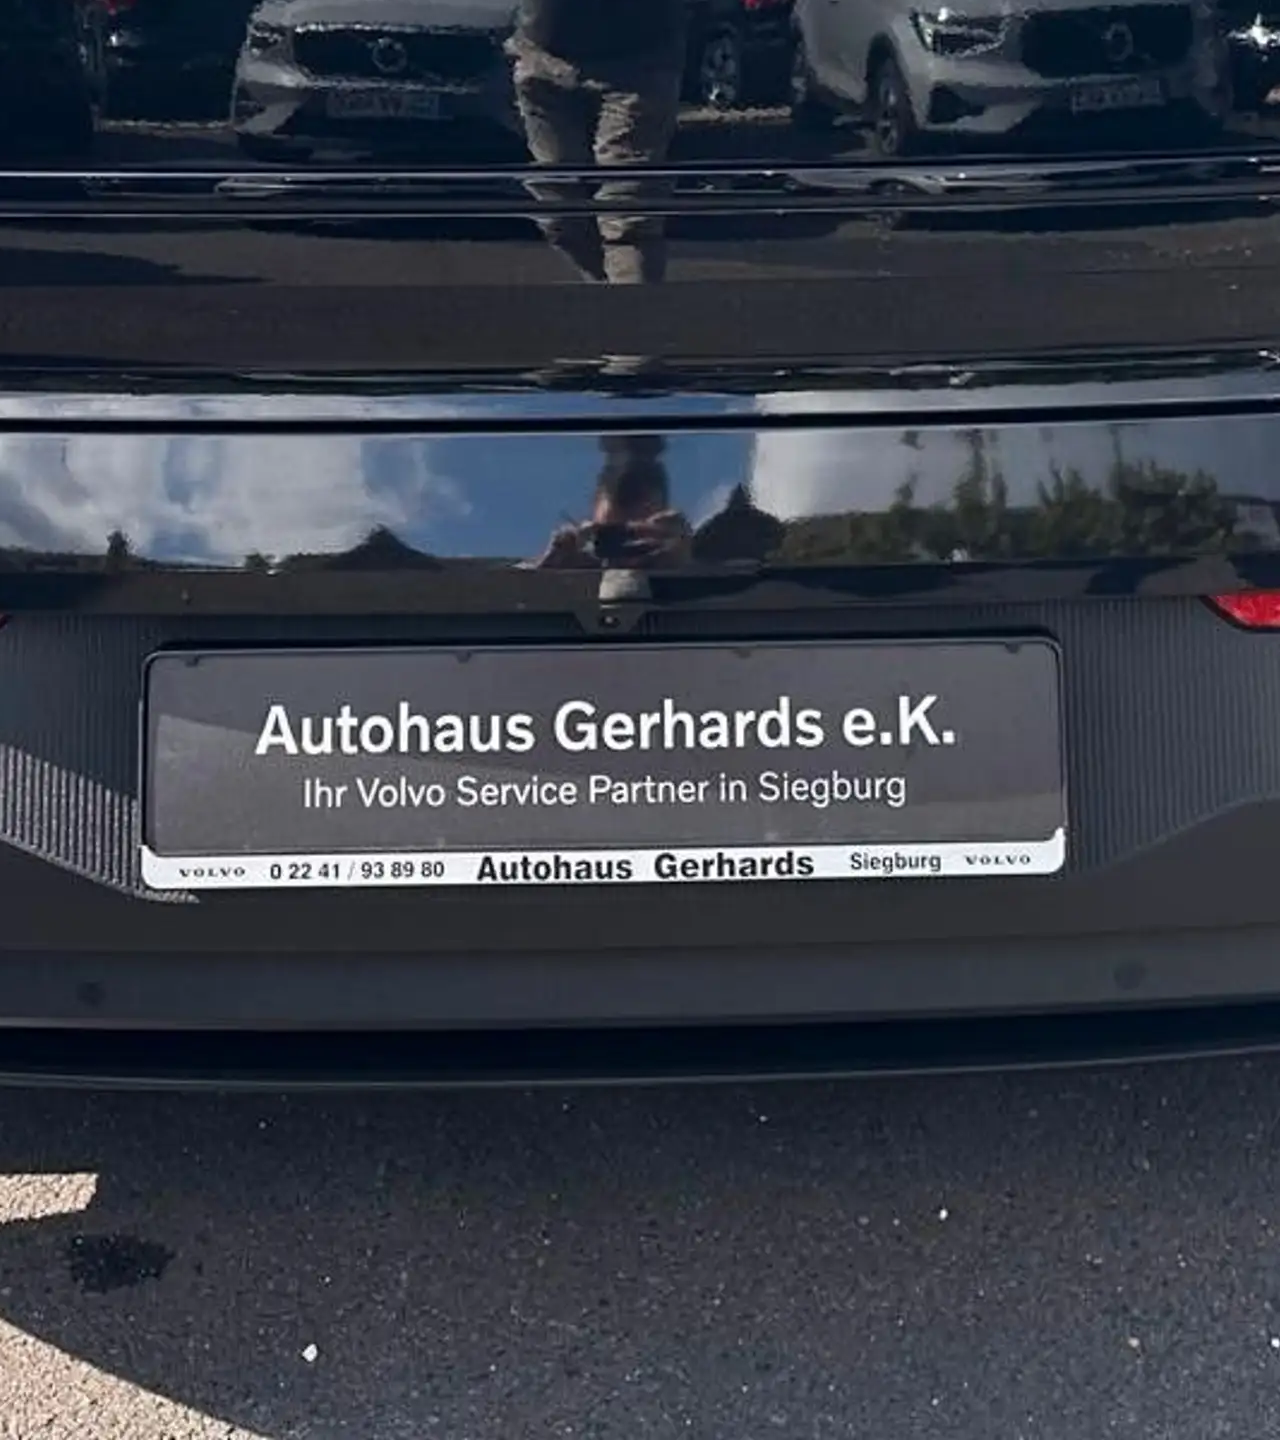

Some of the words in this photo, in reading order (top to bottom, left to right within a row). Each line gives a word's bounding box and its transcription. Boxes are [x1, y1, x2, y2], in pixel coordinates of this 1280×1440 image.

[254, 701, 536, 756] Autohaus
[554, 695, 826, 753] Gerhards
[842, 693, 958, 747] e.K.
[302, 778, 348, 808] Ihr
[357, 776, 447, 808] Volvo
[456, 774, 577, 807] Service
[588, 773, 710, 804] Partner
[719, 772, 748, 801] in
[758, 770, 907, 808] Siegburg
[477, 855, 633, 881] Autohaus
[654, 851, 815, 879] Gerhards
[850, 852, 941, 872] Siegburg
[965, 854, 1031, 866] VOLVO
[178, 866, 246, 878] VOLVO
[270, 863, 282, 880] 0
[288, 863, 311, 880] 22
[319, 863, 339, 879] 41
[360, 862, 384, 879] 93
[390, 861, 414, 878] 89
[420, 861, 445, 878] 80
